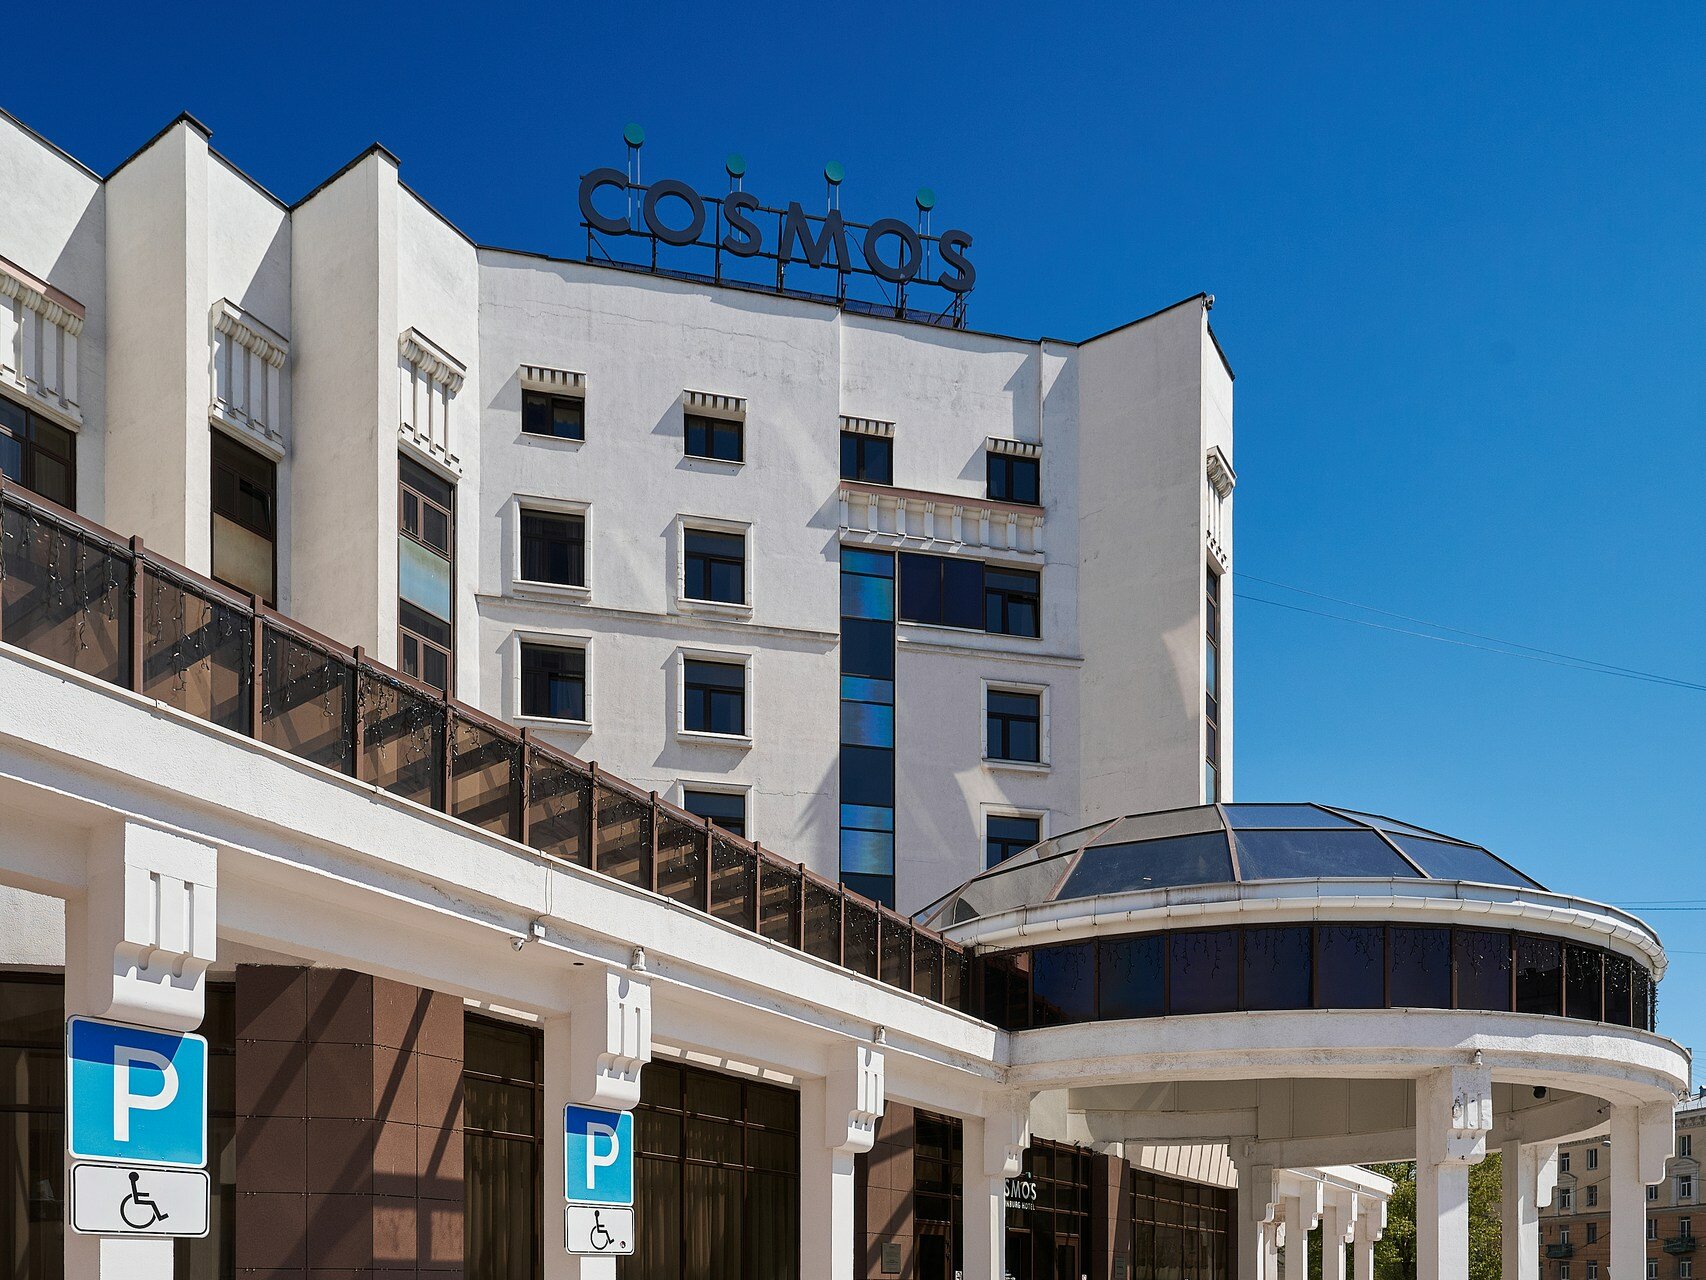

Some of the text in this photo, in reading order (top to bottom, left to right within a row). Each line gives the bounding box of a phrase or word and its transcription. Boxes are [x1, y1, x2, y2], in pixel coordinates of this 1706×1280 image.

[578, 167, 976, 293] COSMOS
[113, 1045, 179, 1142] P
[586, 1121, 620, 1190] P
[1004, 1179, 1037, 1200] SMOS
